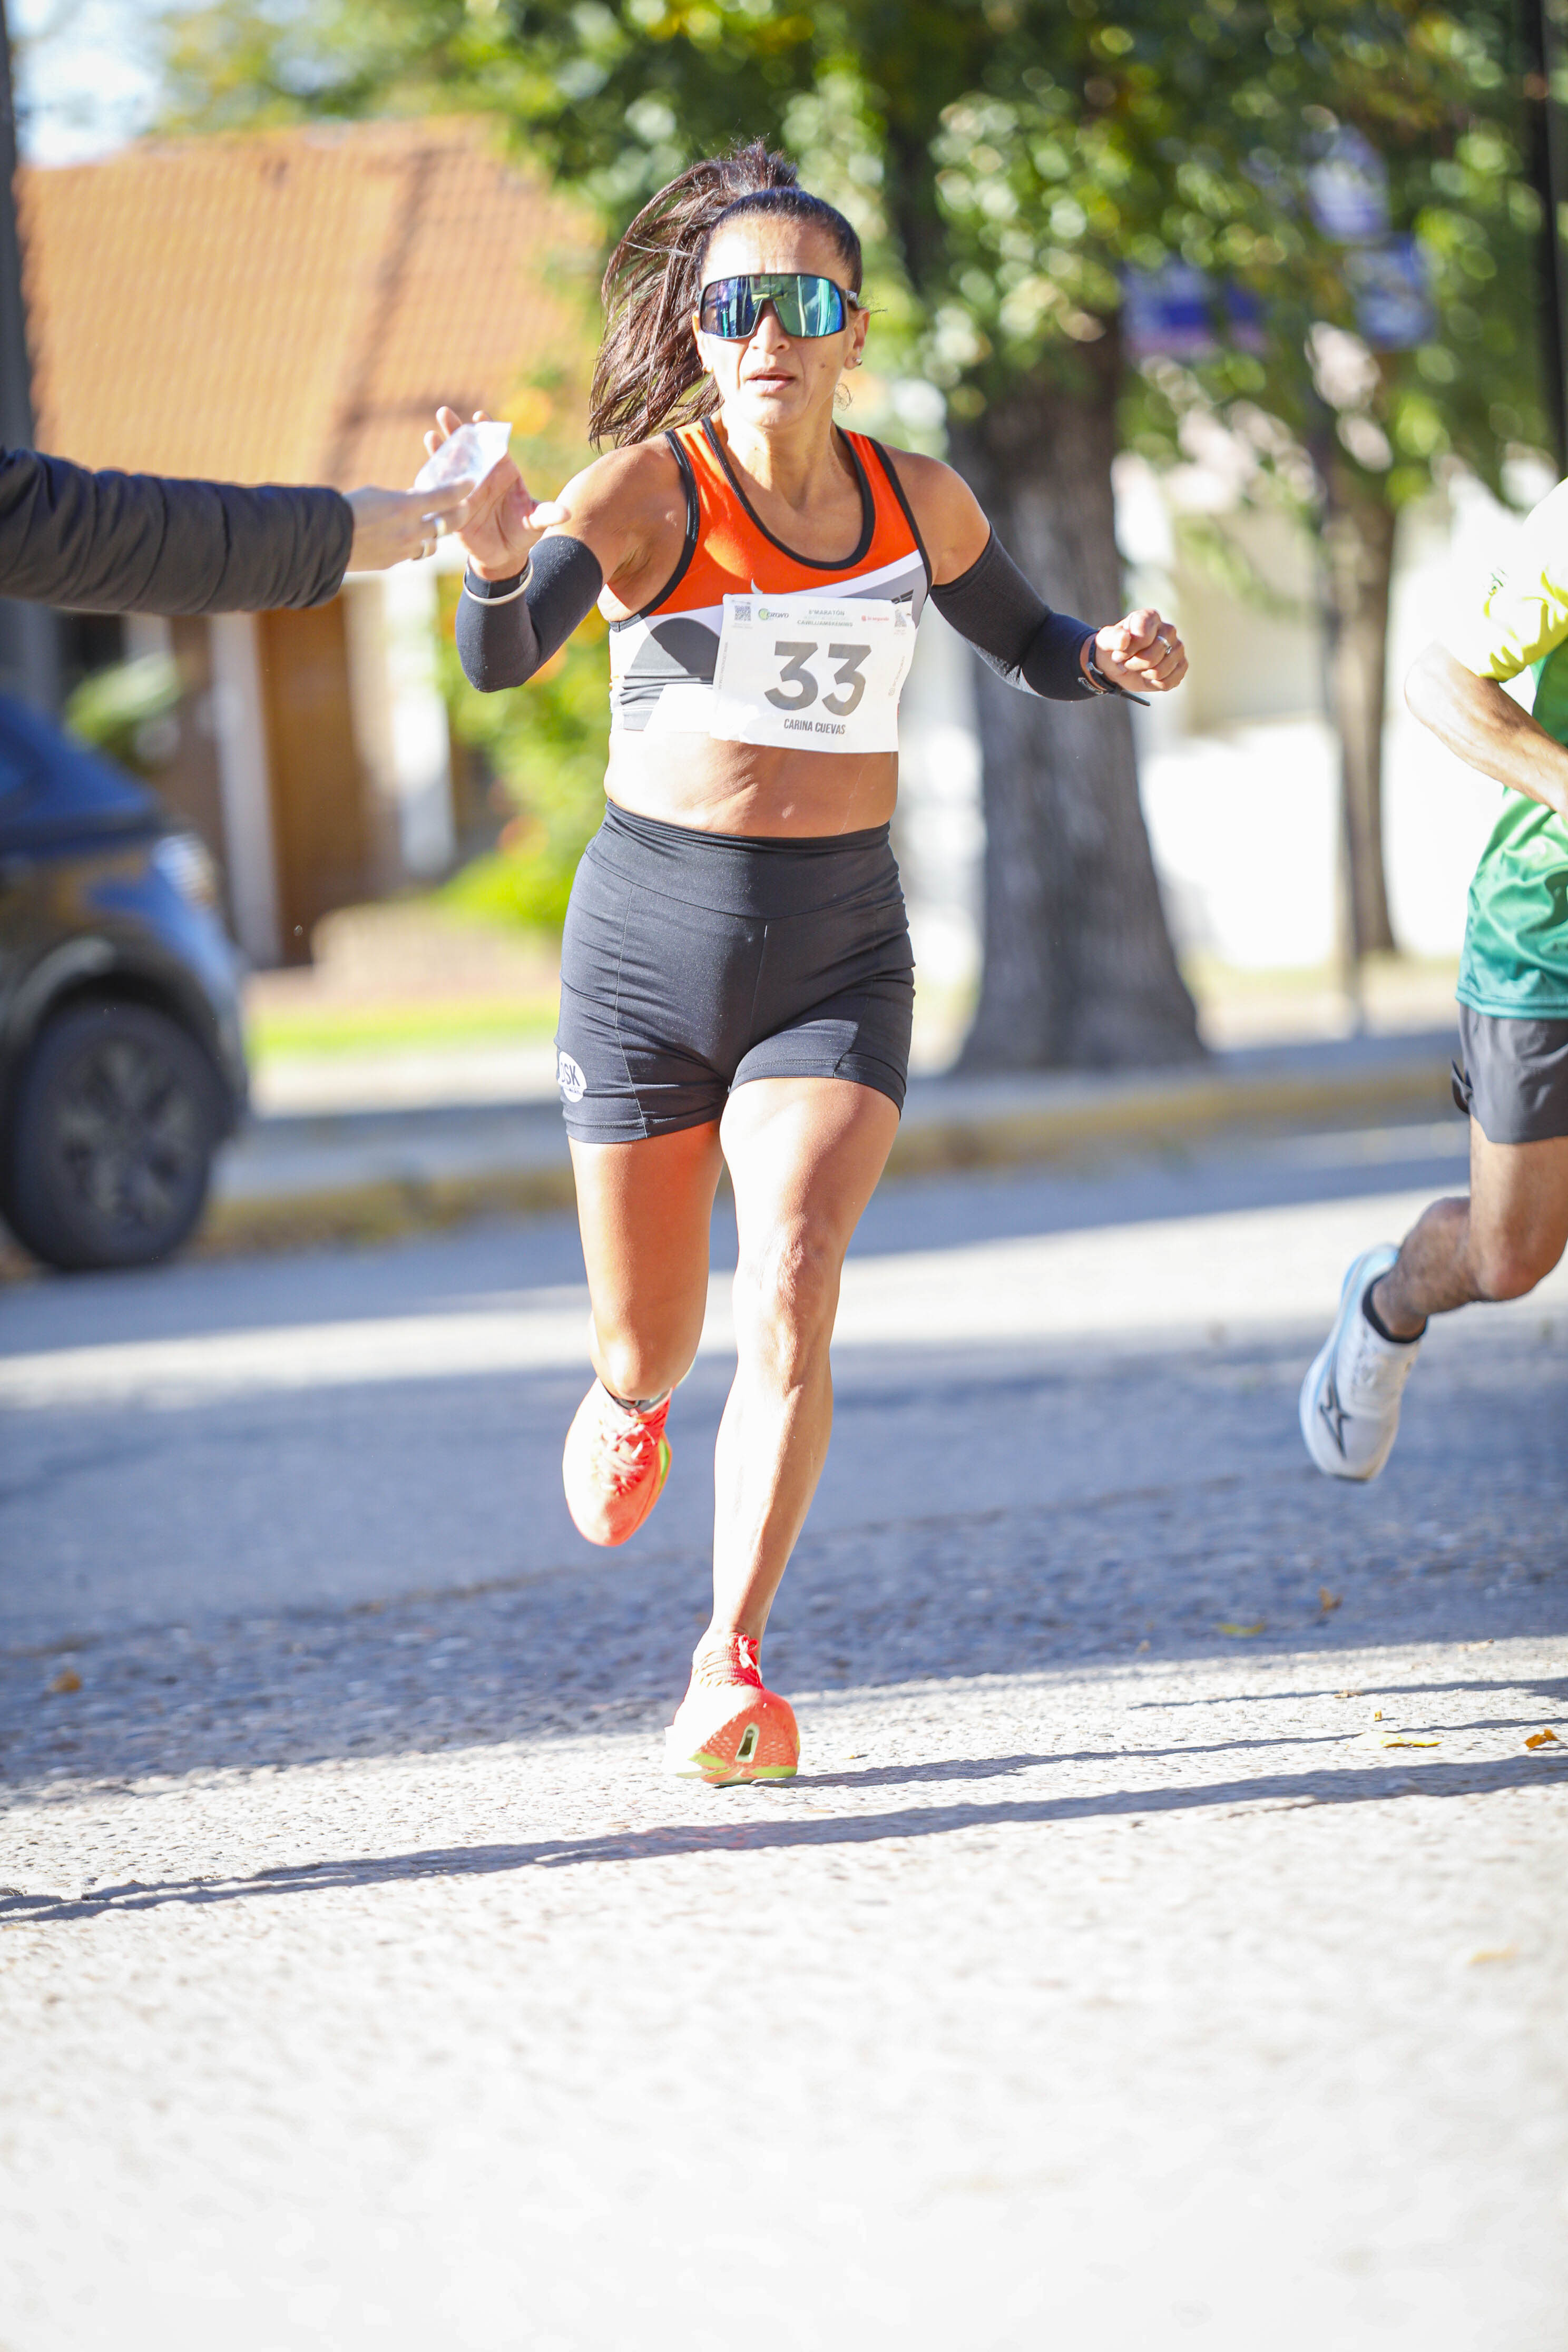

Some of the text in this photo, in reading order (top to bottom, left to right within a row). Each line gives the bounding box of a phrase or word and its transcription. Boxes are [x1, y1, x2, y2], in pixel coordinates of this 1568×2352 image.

[764, 641, 871, 716] 33
[783, 718, 846, 734] CARINA CUEVAS
